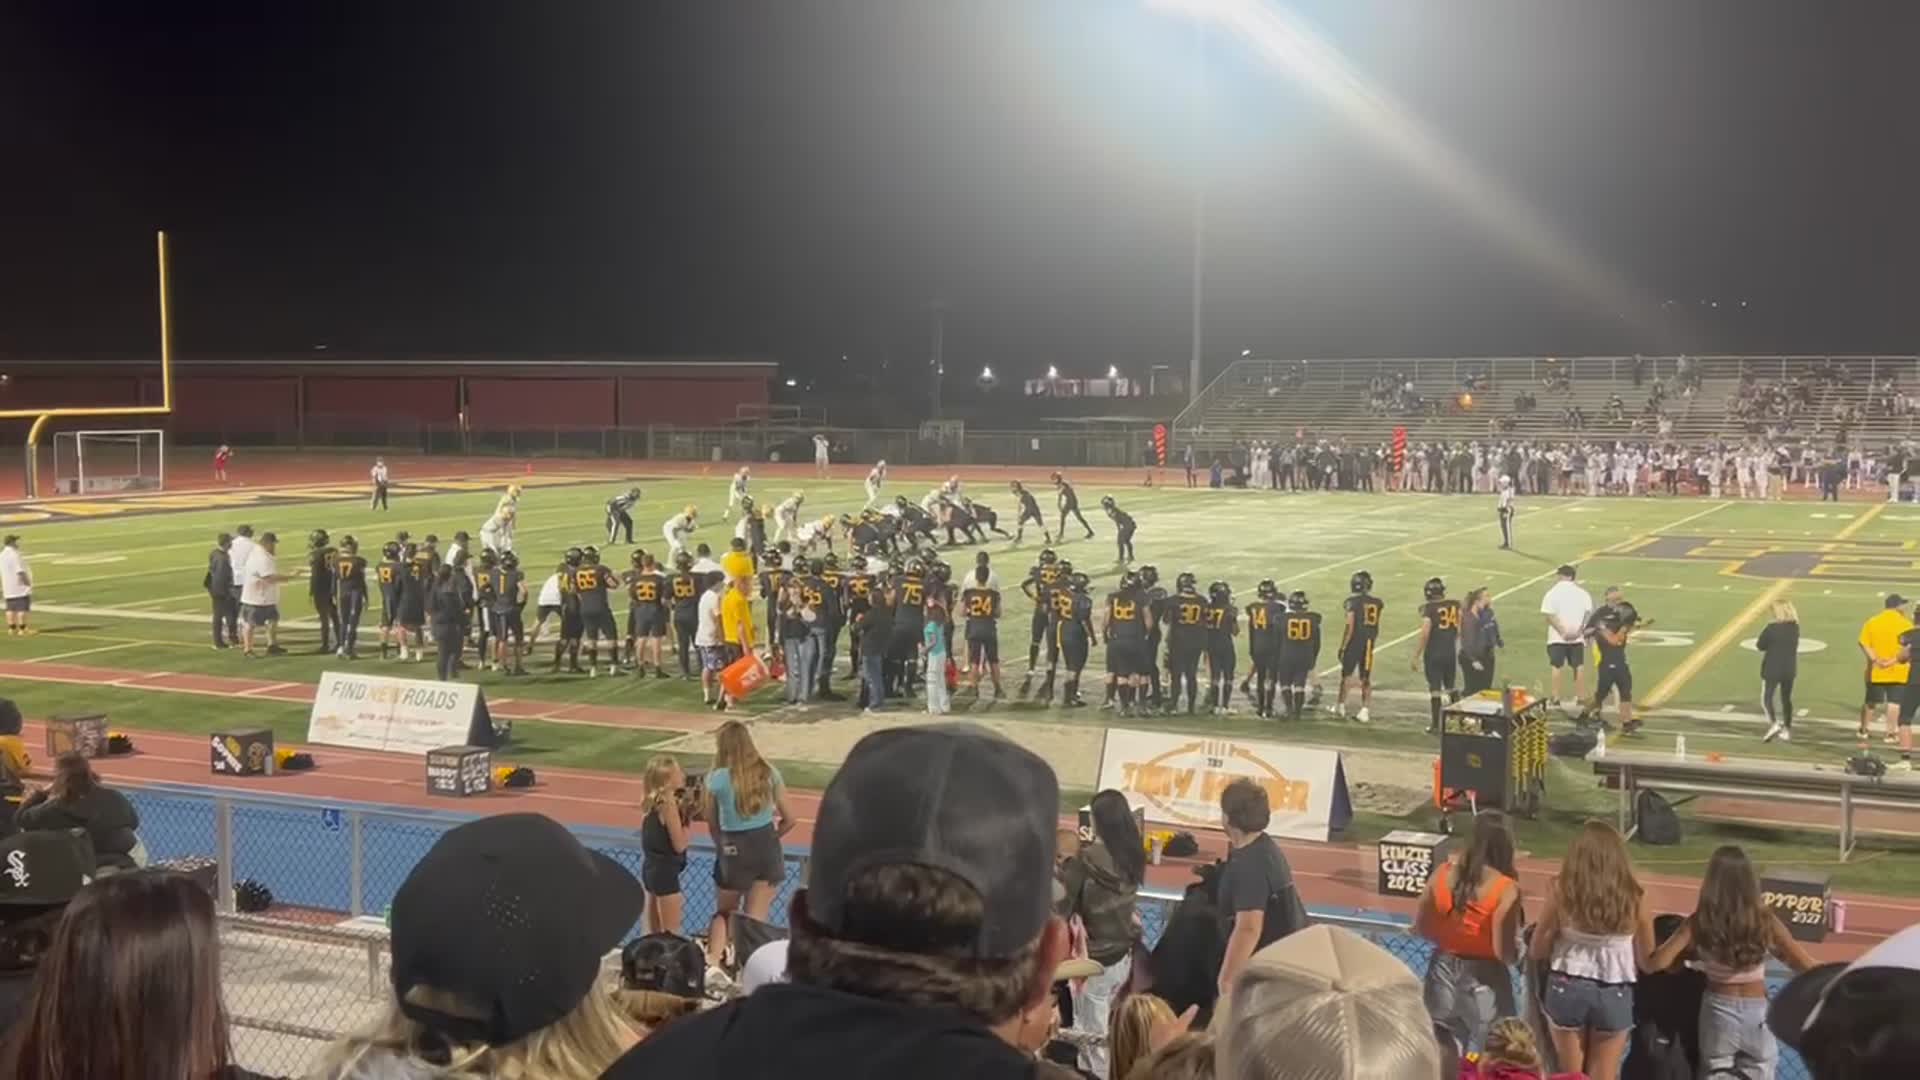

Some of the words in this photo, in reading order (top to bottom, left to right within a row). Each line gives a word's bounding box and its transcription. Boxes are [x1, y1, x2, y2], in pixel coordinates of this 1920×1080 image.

[576, 569, 597, 590] 65
[902, 582, 924, 605] 75
[970, 596, 992, 617] 24
[1179, 604, 1201, 625] 30
[1363, 603, 1379, 626] 13
[1437, 607, 1458, 630] 34
[1287, 618, 1311, 641] 60
[331, 680, 368, 701] FIND
[402, 687, 460, 711] ROADS
[1381, 844, 1432, 863] KINZIE
[1382, 860, 1429, 877] CLASS
[1387, 874, 1426, 893] 2025
[1791, 911, 1822, 925] 2027
